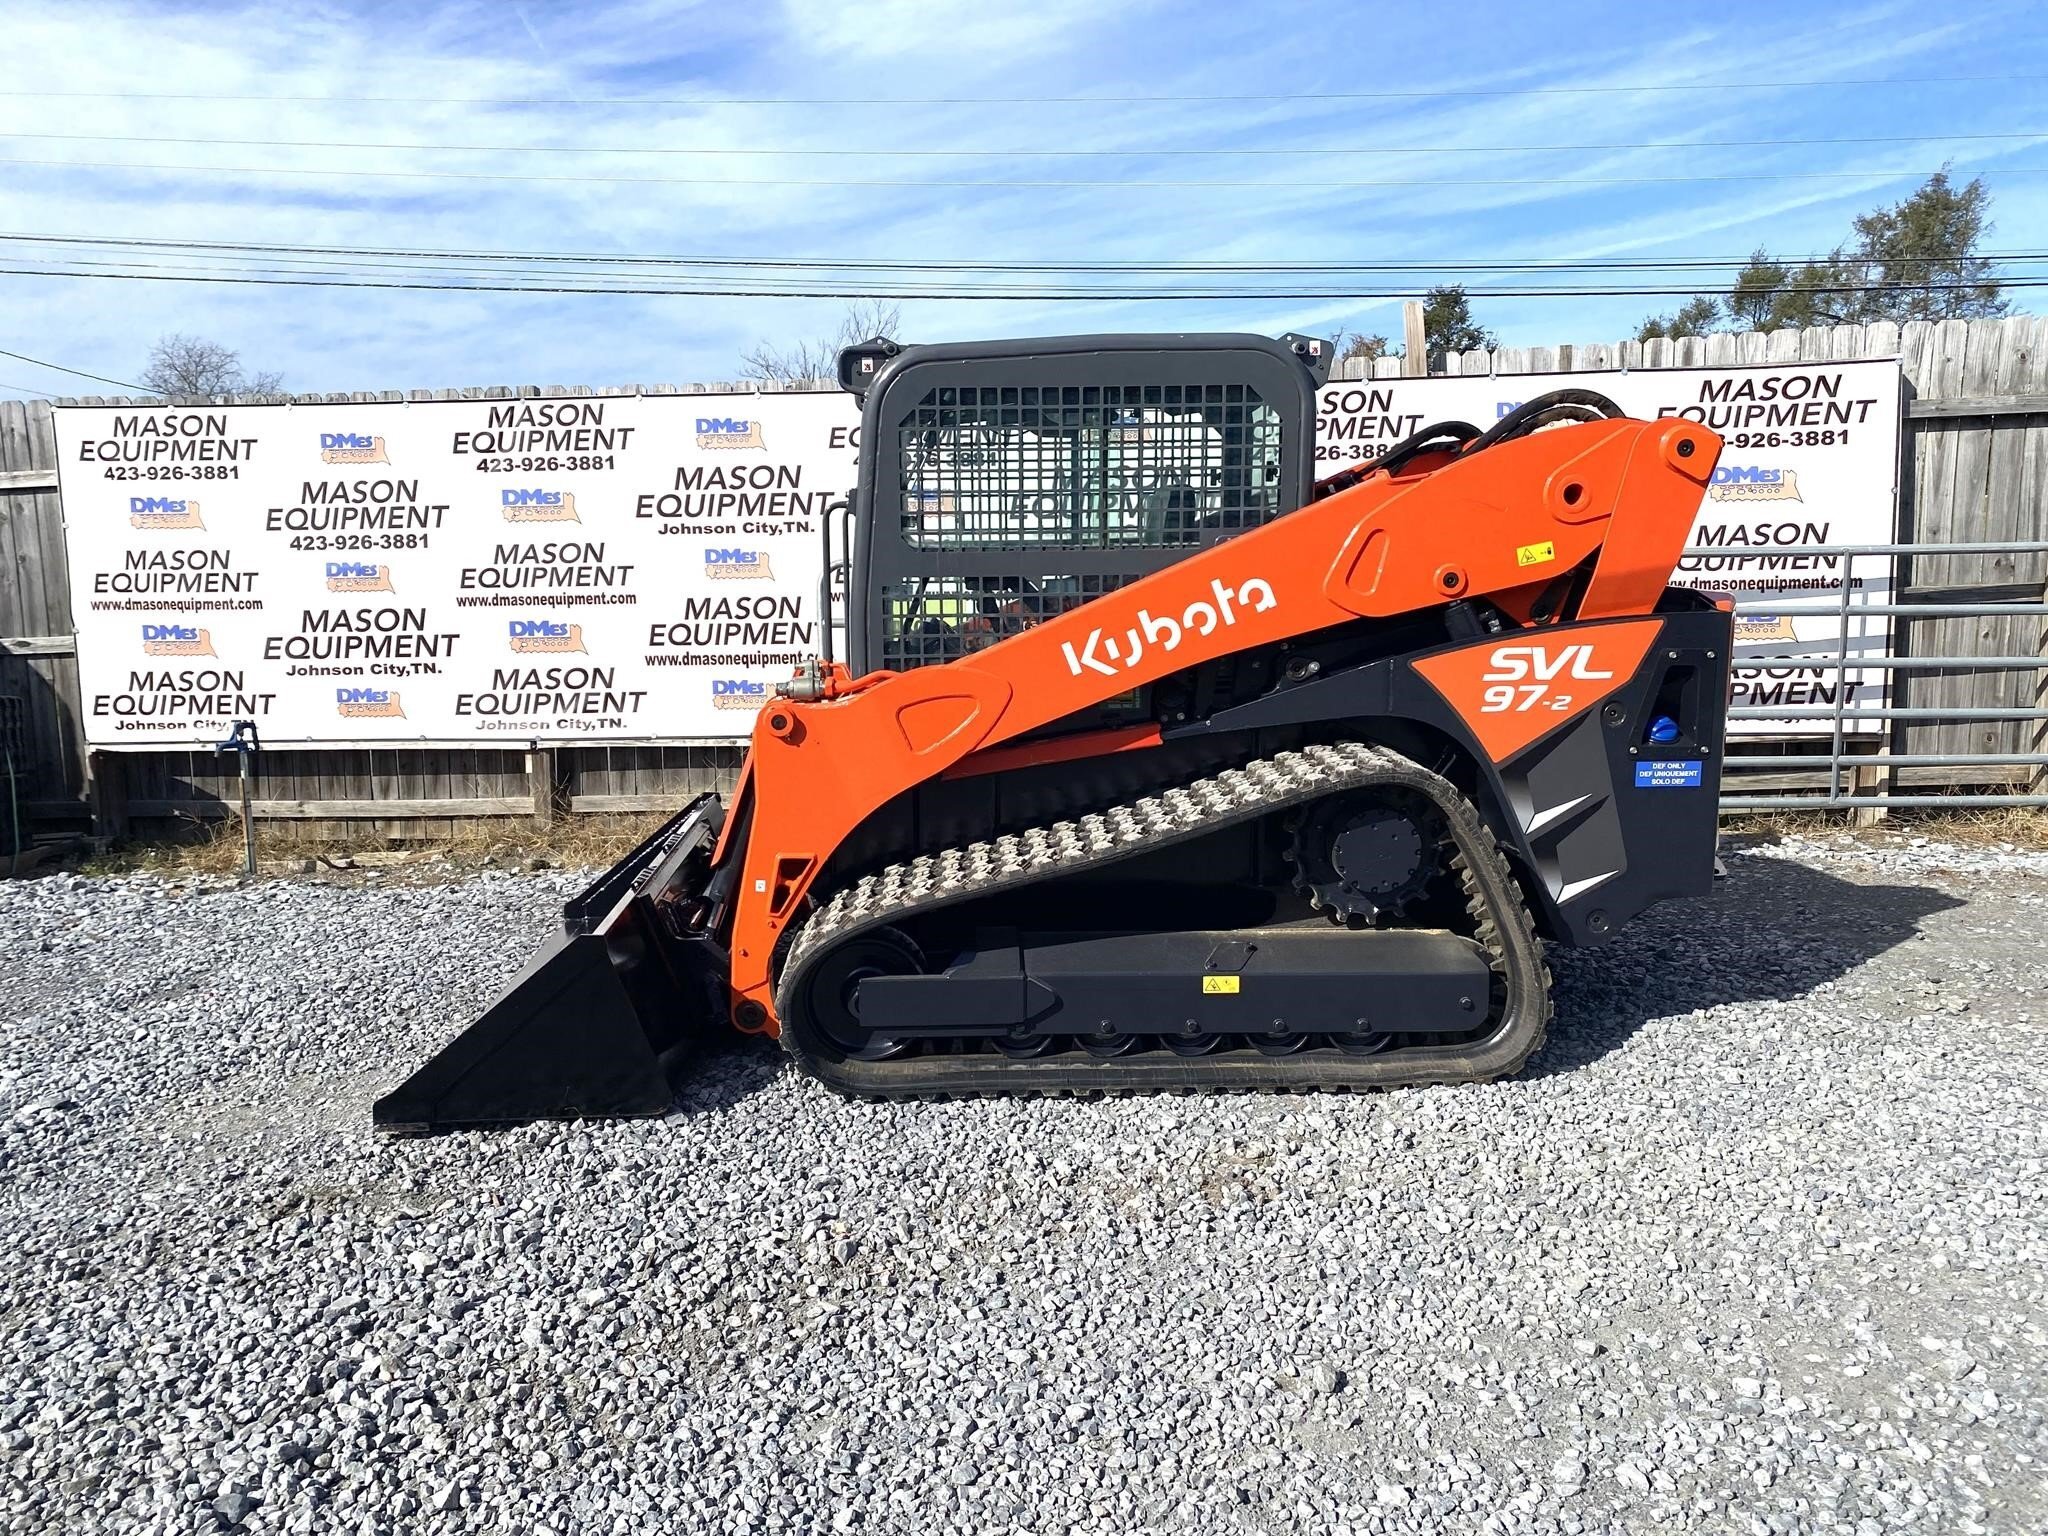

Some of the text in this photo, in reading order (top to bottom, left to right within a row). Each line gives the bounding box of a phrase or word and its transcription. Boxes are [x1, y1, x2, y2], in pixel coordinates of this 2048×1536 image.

[1699, 374, 1842, 402] MASON
[114, 415, 227, 437] MASON
[488, 402, 604, 428] MASON
[79, 439, 258, 462] EQUIPMENT
[453, 428, 635, 454] EQUIPMENT
[104, 466, 238, 480] 423-926-3881
[476, 455, 614, 473] 423-926-3881
[675, 465, 801, 490] MASON
[302, 480, 418, 504] MASON
[636, 492, 835, 518] EQUIPMENT
[266, 505, 450, 531] EQUIPMENT
[658, 523, 735, 535] Johnson
[290, 533, 428, 551] 423-926-3881
[1696, 522, 1829, 546] MASON
[125, 550, 230, 570] MASON
[494, 542, 605, 564] MASON
[94, 572, 259, 593] EQUIPMENT
[460, 565, 634, 589] EQUIPMENT
[91, 597, 263, 613] www.dmasonequipment.com
[456, 592, 636, 608] www.dmasonequipment.com
[684, 596, 801, 620] MASON
[302, 608, 426, 633] MASON
[1061, 578, 1278, 676] Kubota
[650, 622, 818, 646] EQUIPMEN
[264, 634, 460, 659] EQUIPMENT
[286, 665, 363, 676] Johnson
[1482, 645, 1614, 681] SVL
[129, 671, 243, 692] MASON
[492, 667, 615, 690] MASON
[93, 694, 276, 716] EQUIPMENT
[456, 691, 647, 715] EQUIPMENT
[1480, 684, 1573, 712] 97-2
[115, 720, 186, 730] Johnson
[476, 720, 549, 730] Johnson
